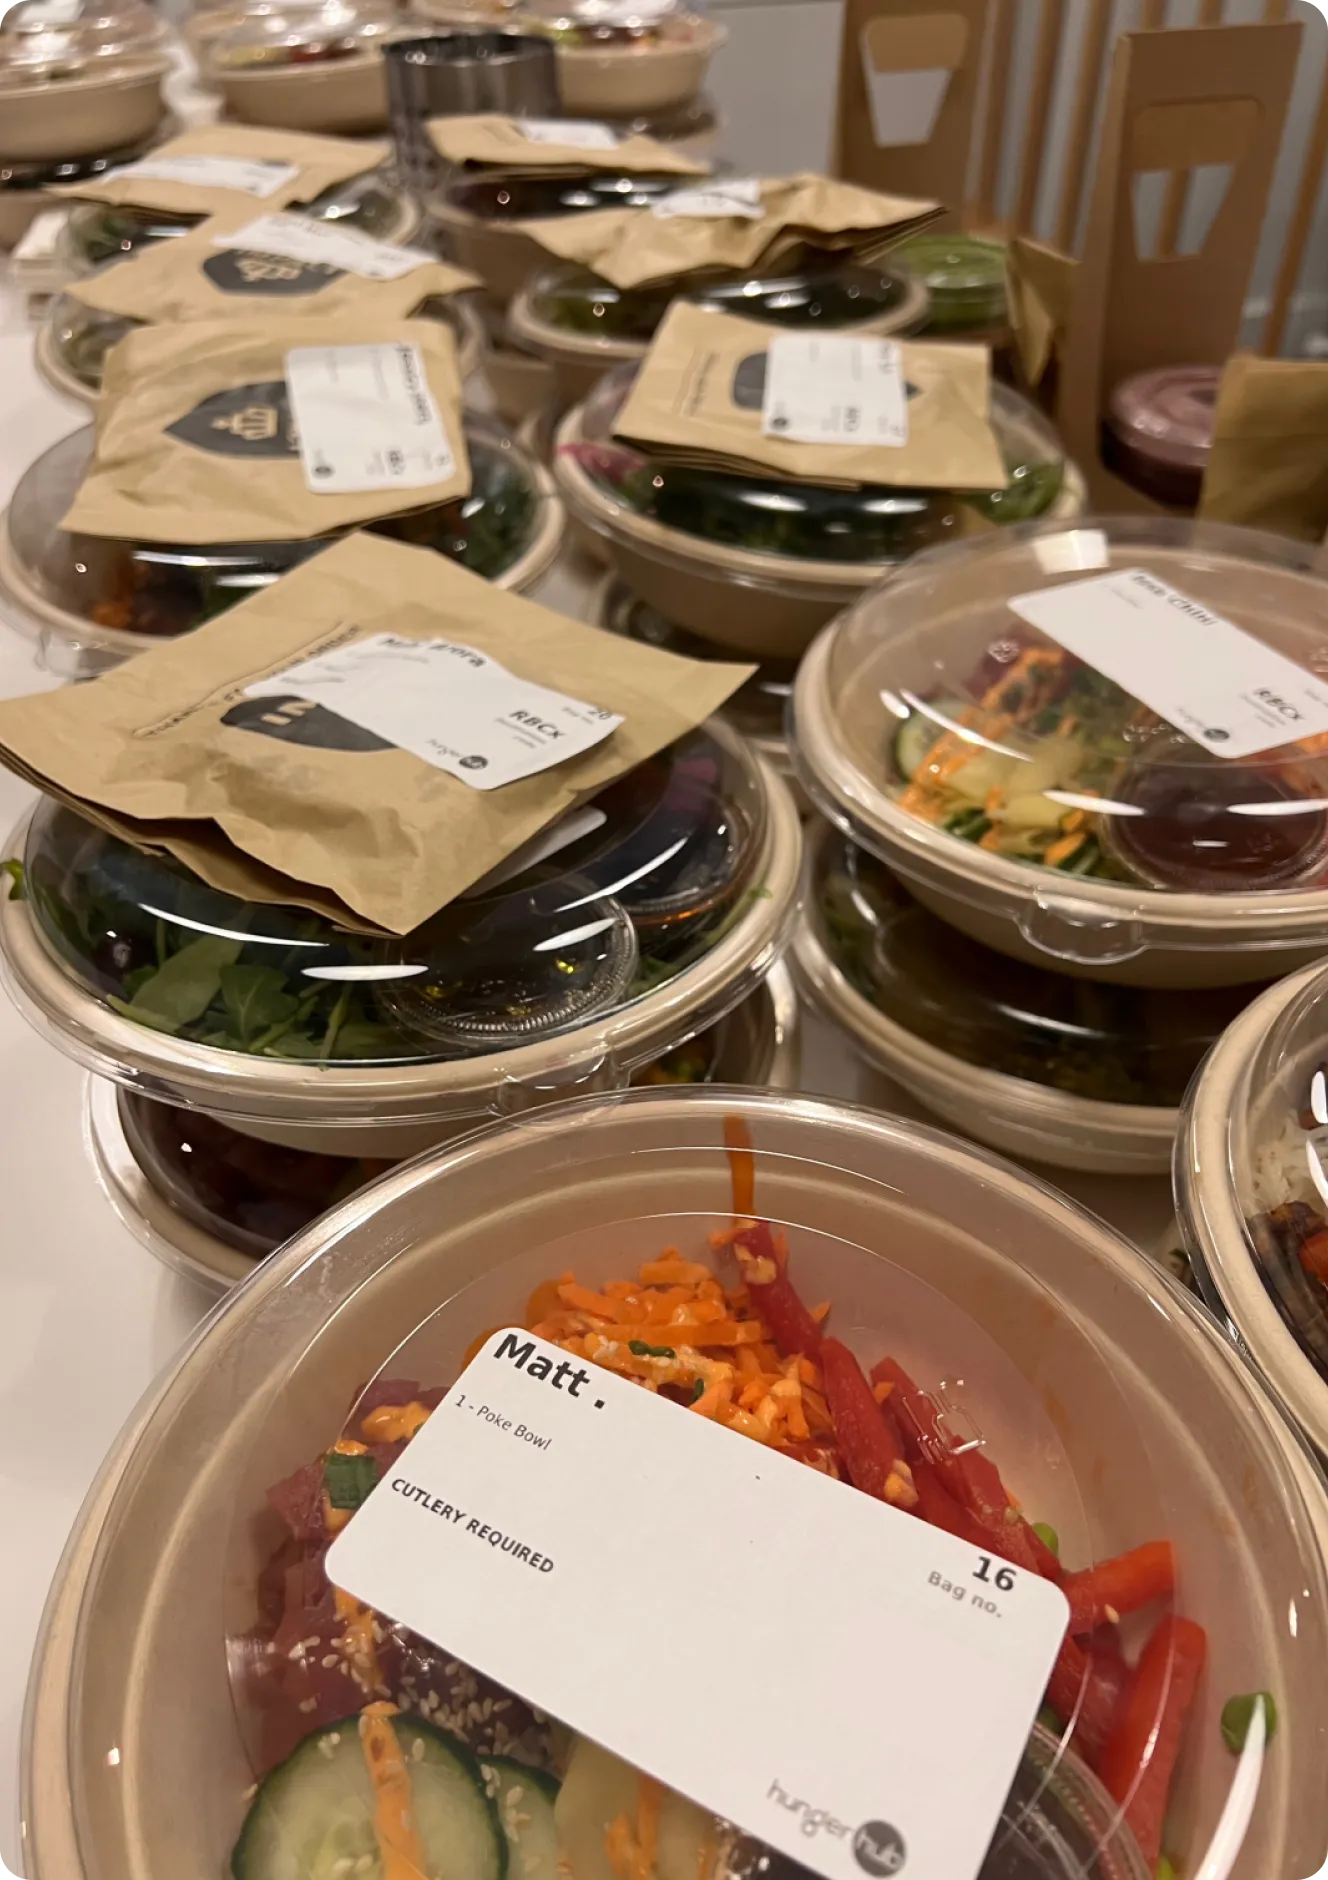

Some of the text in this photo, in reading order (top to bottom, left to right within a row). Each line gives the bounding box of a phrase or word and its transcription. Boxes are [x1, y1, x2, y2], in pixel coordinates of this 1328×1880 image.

[492, 1333, 590, 1398] Matt
[454, 1394, 467, 1408] 1
[476, 1405, 513, 1432] Poke
[513, 1423, 553, 1451] Bowl
[391, 1477, 555, 1574] CUTLERY REQUIRED
[927, 1570, 1003, 1619] Bag no.
[971, 1555, 1018, 1592] 16
